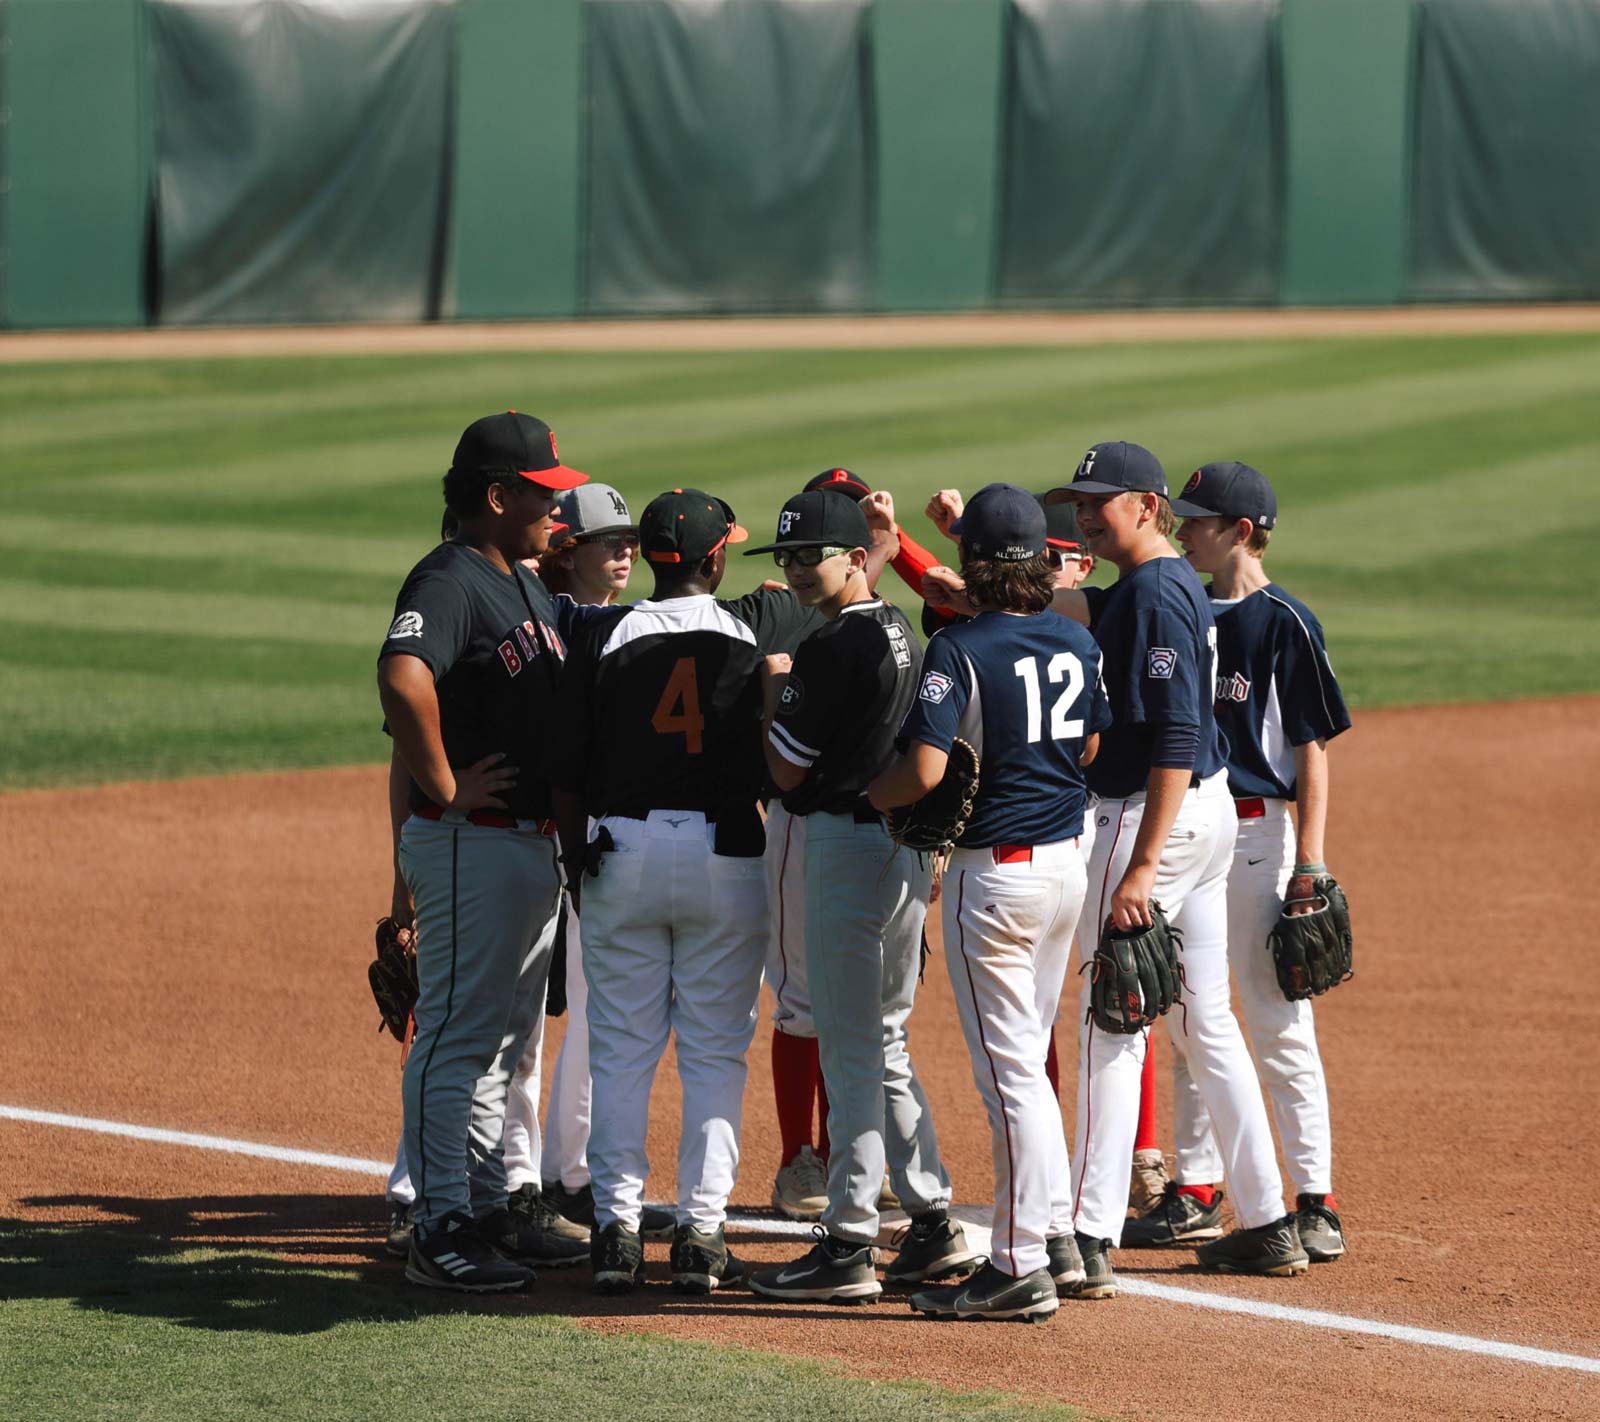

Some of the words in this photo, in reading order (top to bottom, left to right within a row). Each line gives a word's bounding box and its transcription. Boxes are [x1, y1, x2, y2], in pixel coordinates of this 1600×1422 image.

[1078, 450, 1097, 476] G
[606, 491, 628, 515] LA
[995, 551, 1009, 559] ALL
[1012, 550, 1034, 560] STARS
[651, 657, 705, 753] 4
[1014, 651, 1085, 743] 12
